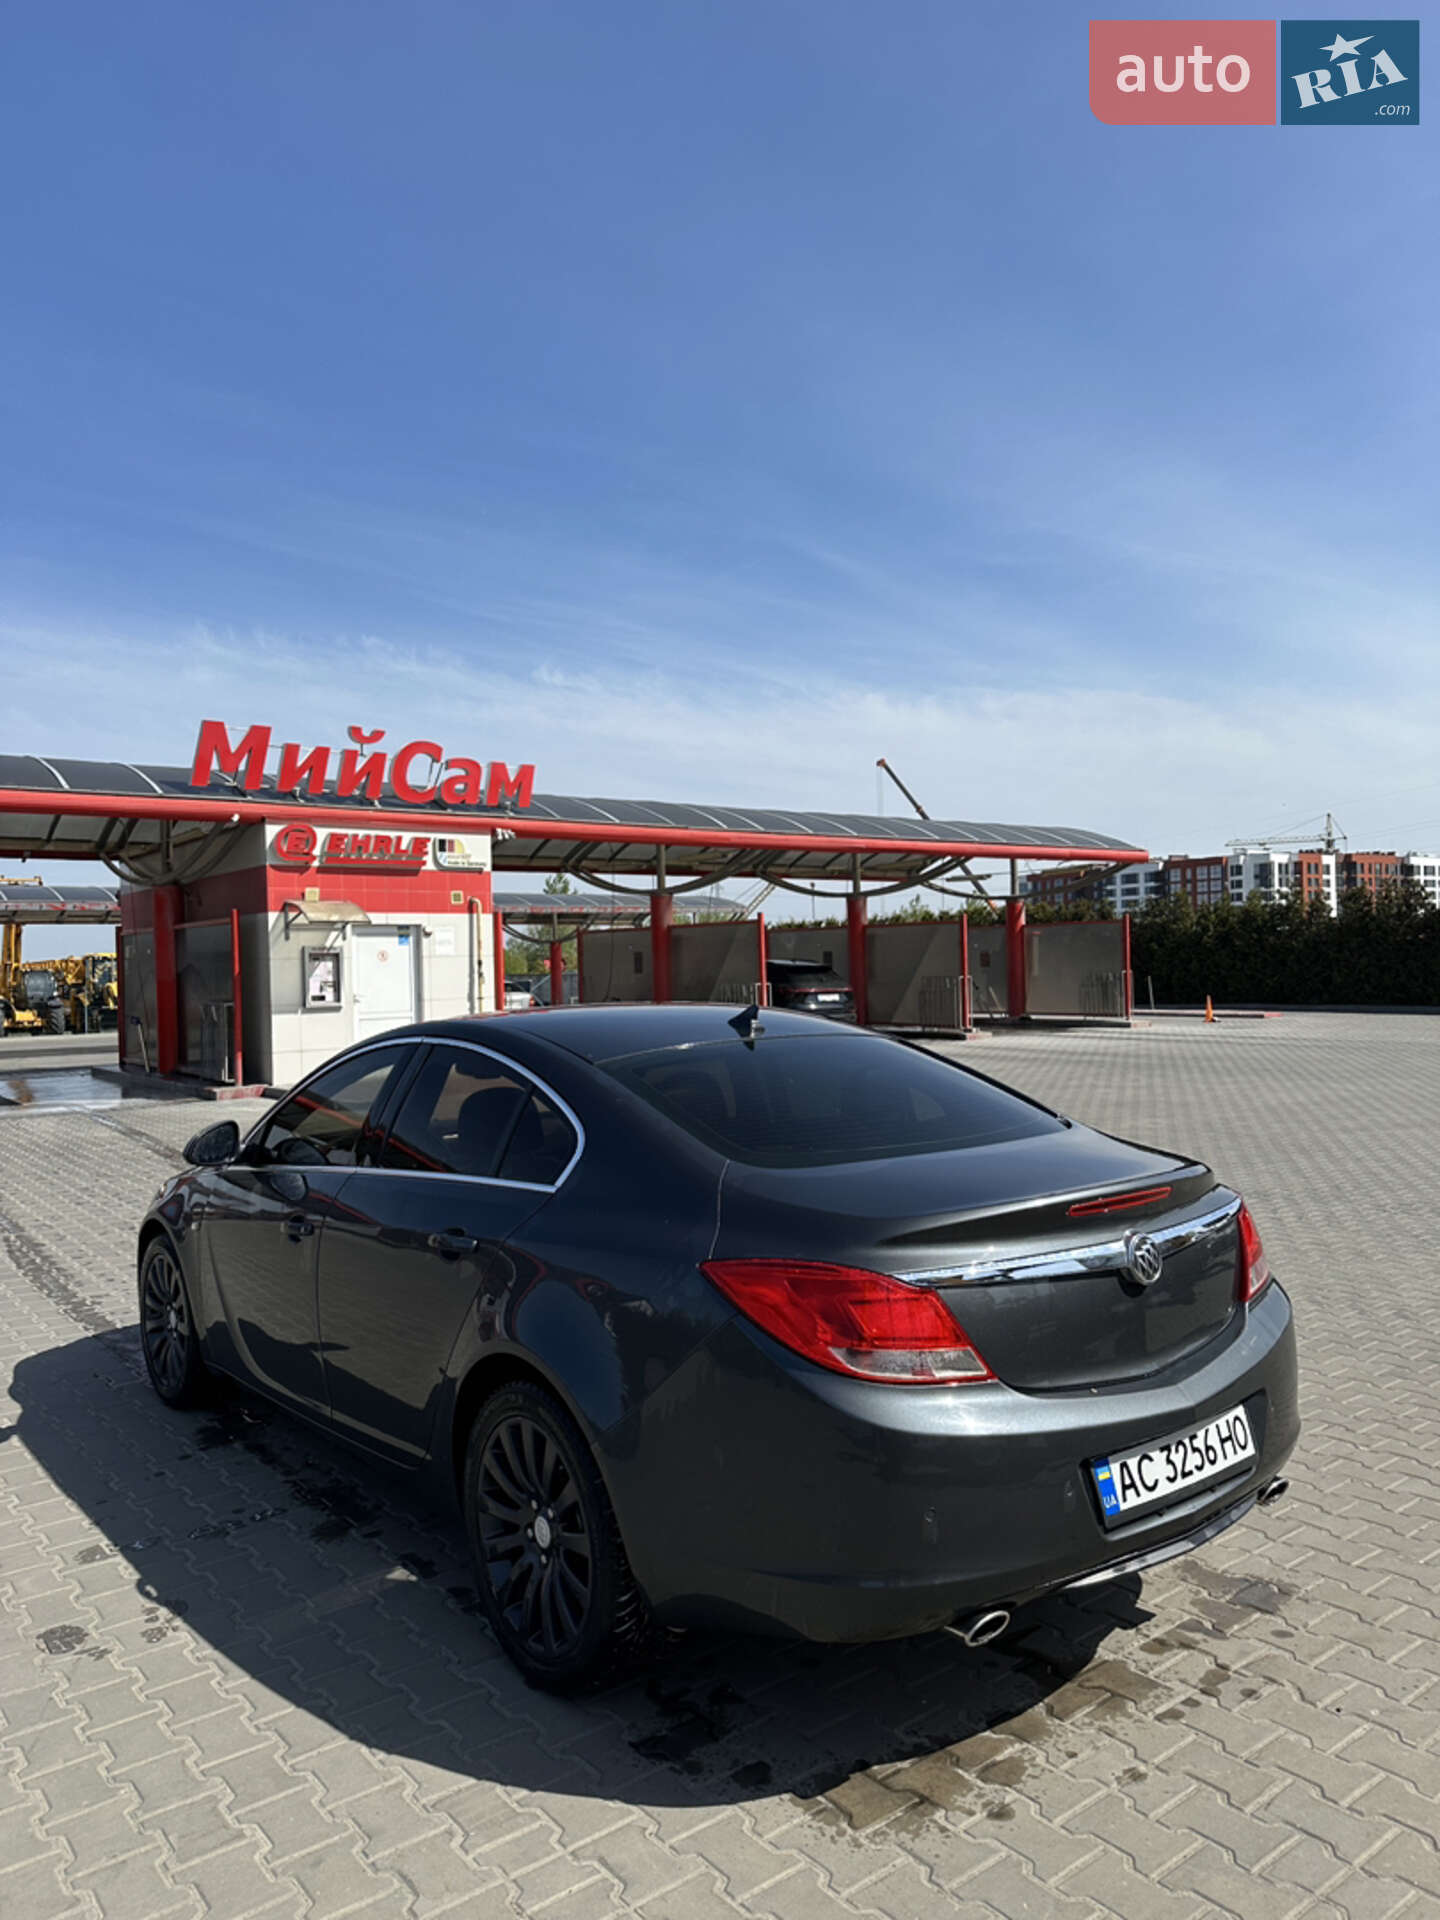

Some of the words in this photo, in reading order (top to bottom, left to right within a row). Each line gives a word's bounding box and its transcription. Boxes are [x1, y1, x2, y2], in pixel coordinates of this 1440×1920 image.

[191, 719, 536, 808] МийСам
[327, 832, 431, 855] EHRLE
[1119, 1453, 1159, 1503] AC
[1159, 1428, 1218, 1484] 3256
[1216, 1415, 1249, 1460] HO
[1103, 1496, 1118, 1508] UA
